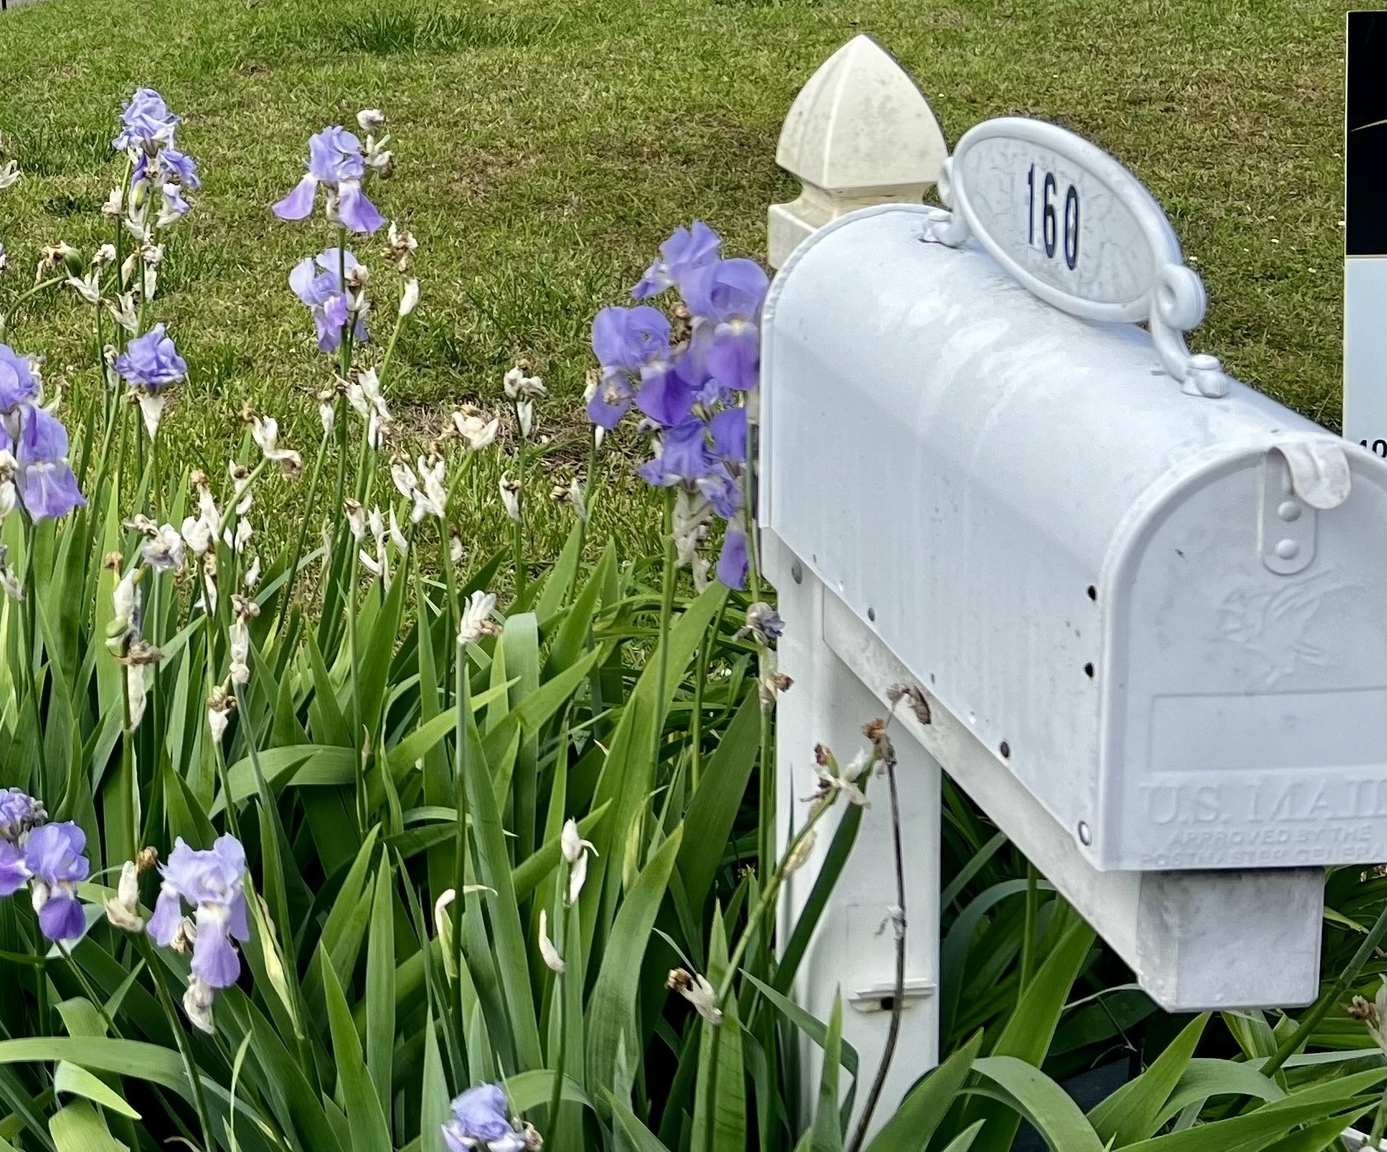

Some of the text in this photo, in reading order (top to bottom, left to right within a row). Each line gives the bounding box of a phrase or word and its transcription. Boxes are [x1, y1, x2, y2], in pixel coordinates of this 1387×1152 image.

[1027, 162, 1079, 271] 160
[1138, 782, 1231, 826] U.S.
[1166, 821, 1375, 847] APPROVED BY THE
